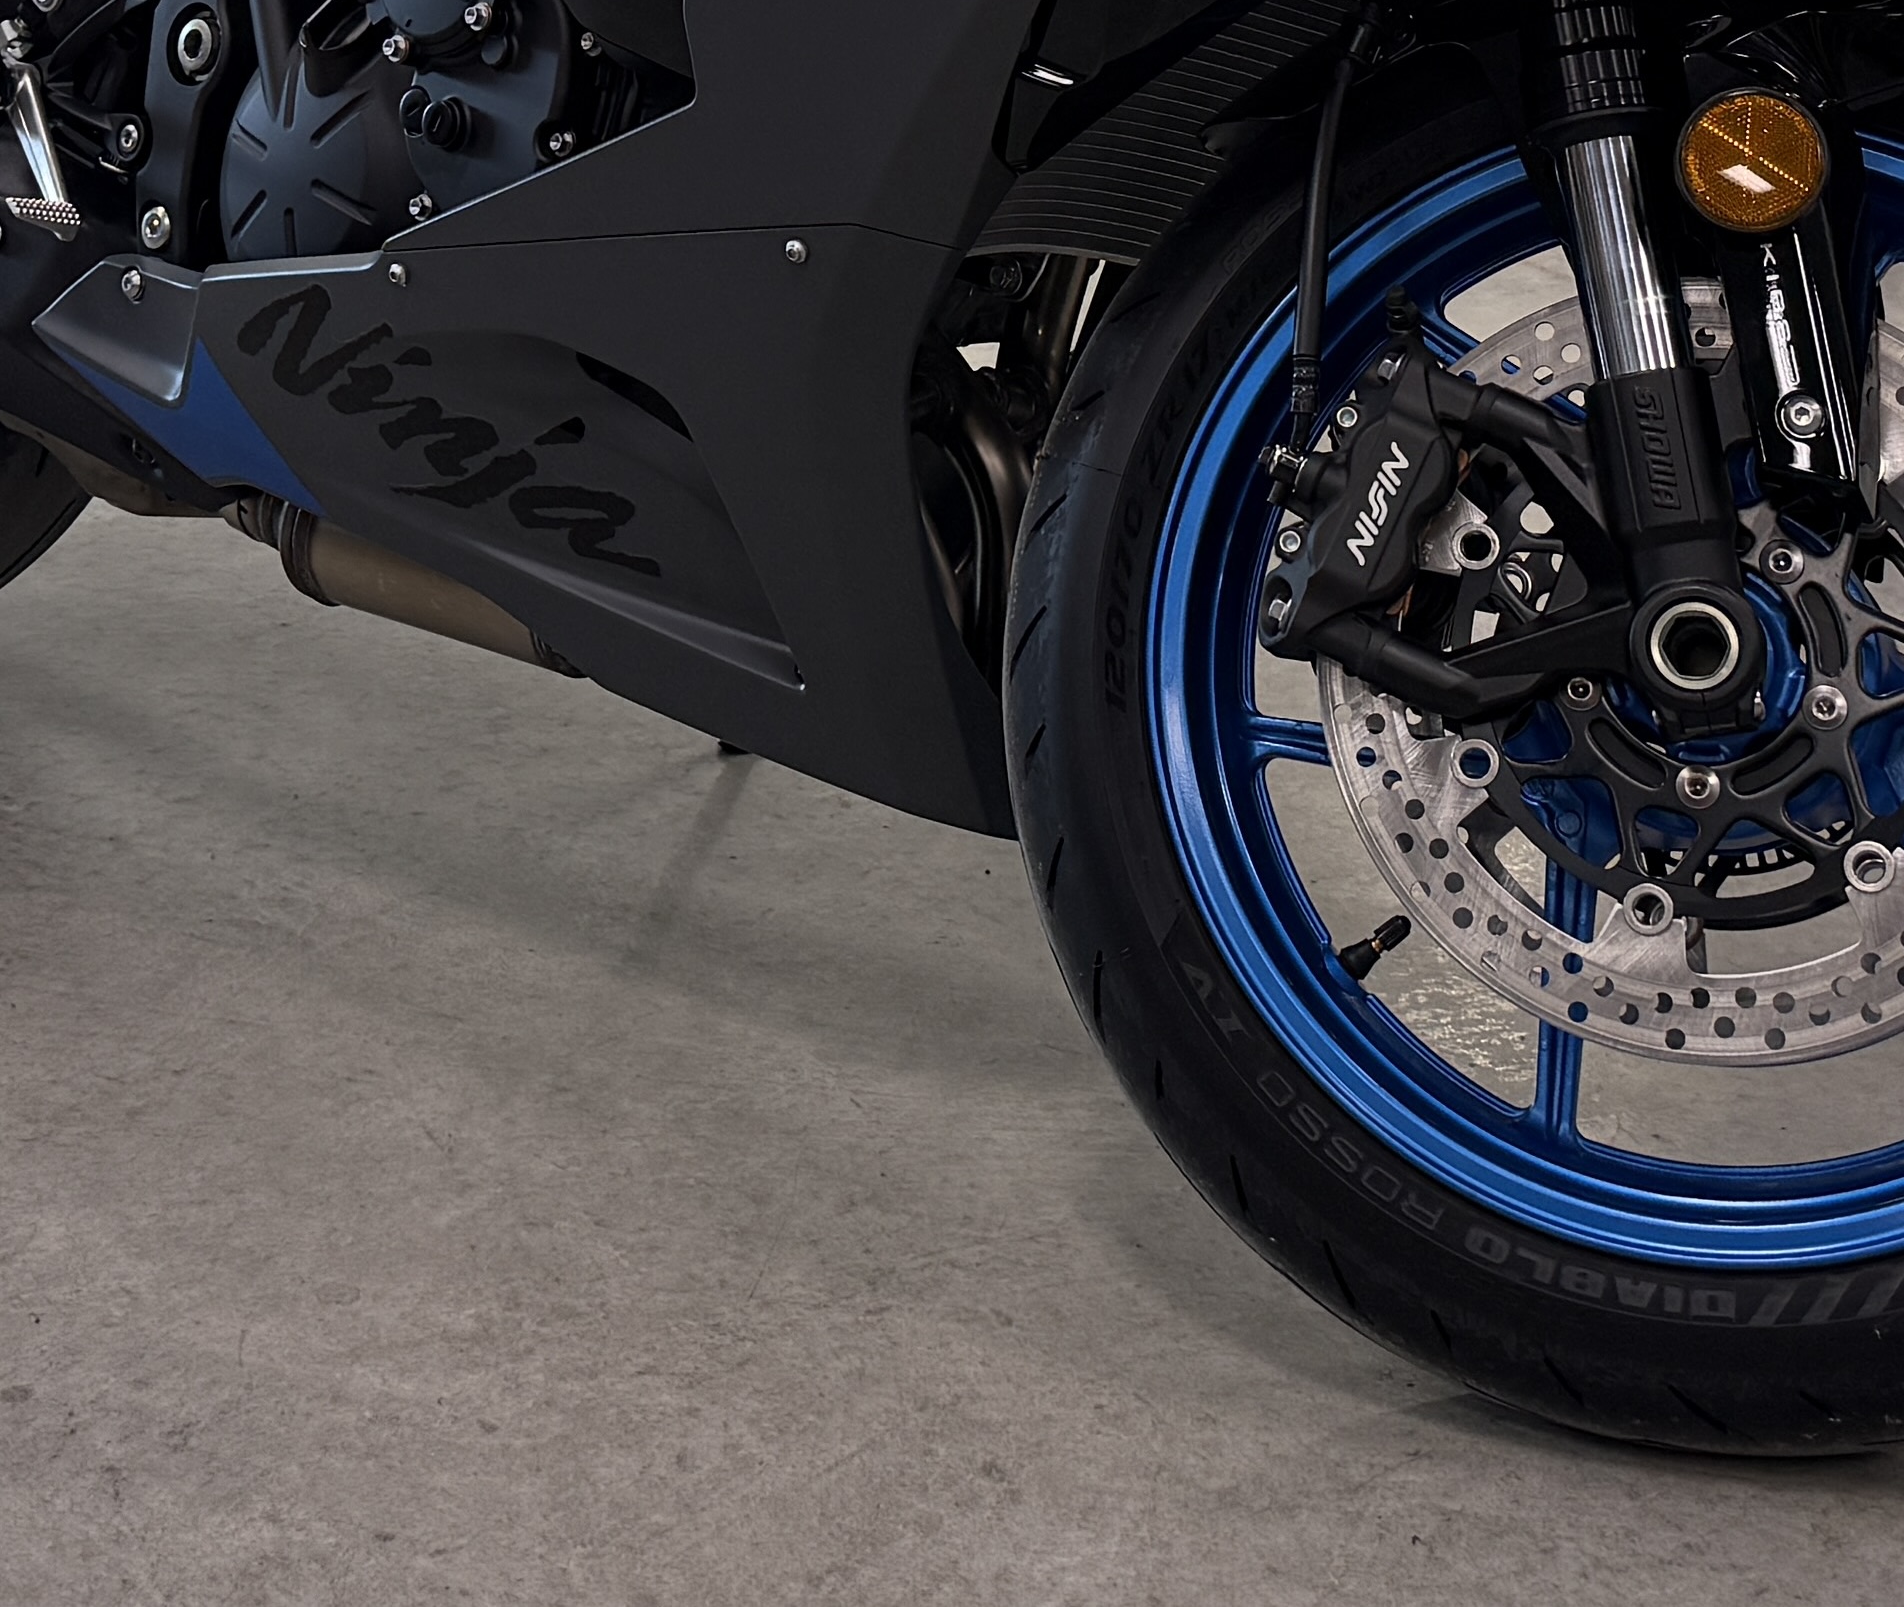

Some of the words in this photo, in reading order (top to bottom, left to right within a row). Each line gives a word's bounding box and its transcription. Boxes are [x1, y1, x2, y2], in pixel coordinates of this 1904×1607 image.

[236, 284, 662, 578] Ninja
[1633, 384, 1682, 511] SHOWA
[1346, 441, 1410, 567] NISSIN
[1256, 1069, 1448, 1220] ROSSO
[1463, 1226, 1739, 1323] DIABLO
